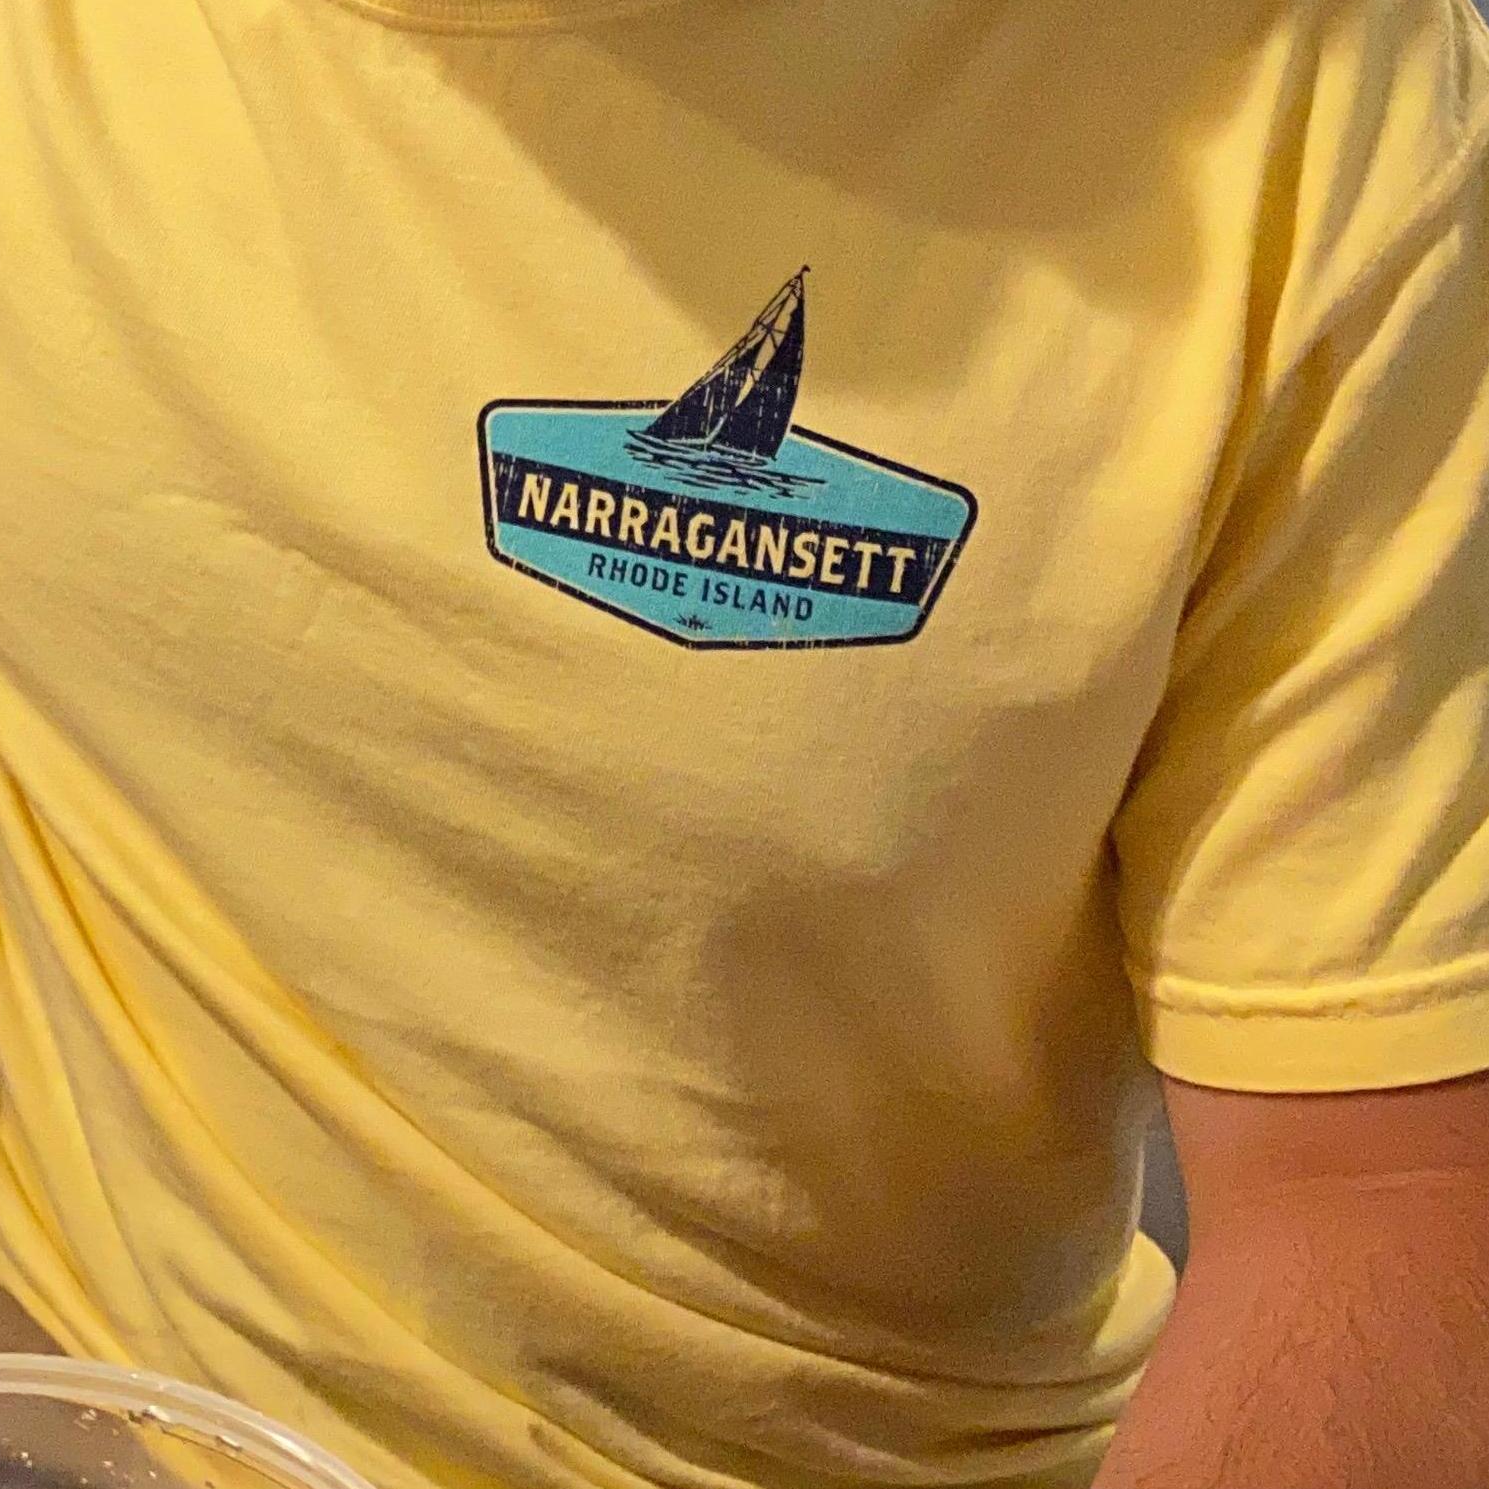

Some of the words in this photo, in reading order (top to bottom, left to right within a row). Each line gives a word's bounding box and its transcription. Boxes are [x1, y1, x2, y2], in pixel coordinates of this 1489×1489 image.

[519, 473, 916, 594] NARRAGANSETT
[588, 553, 687, 597] RHODE
[701, 578, 814, 622] ISLAND
